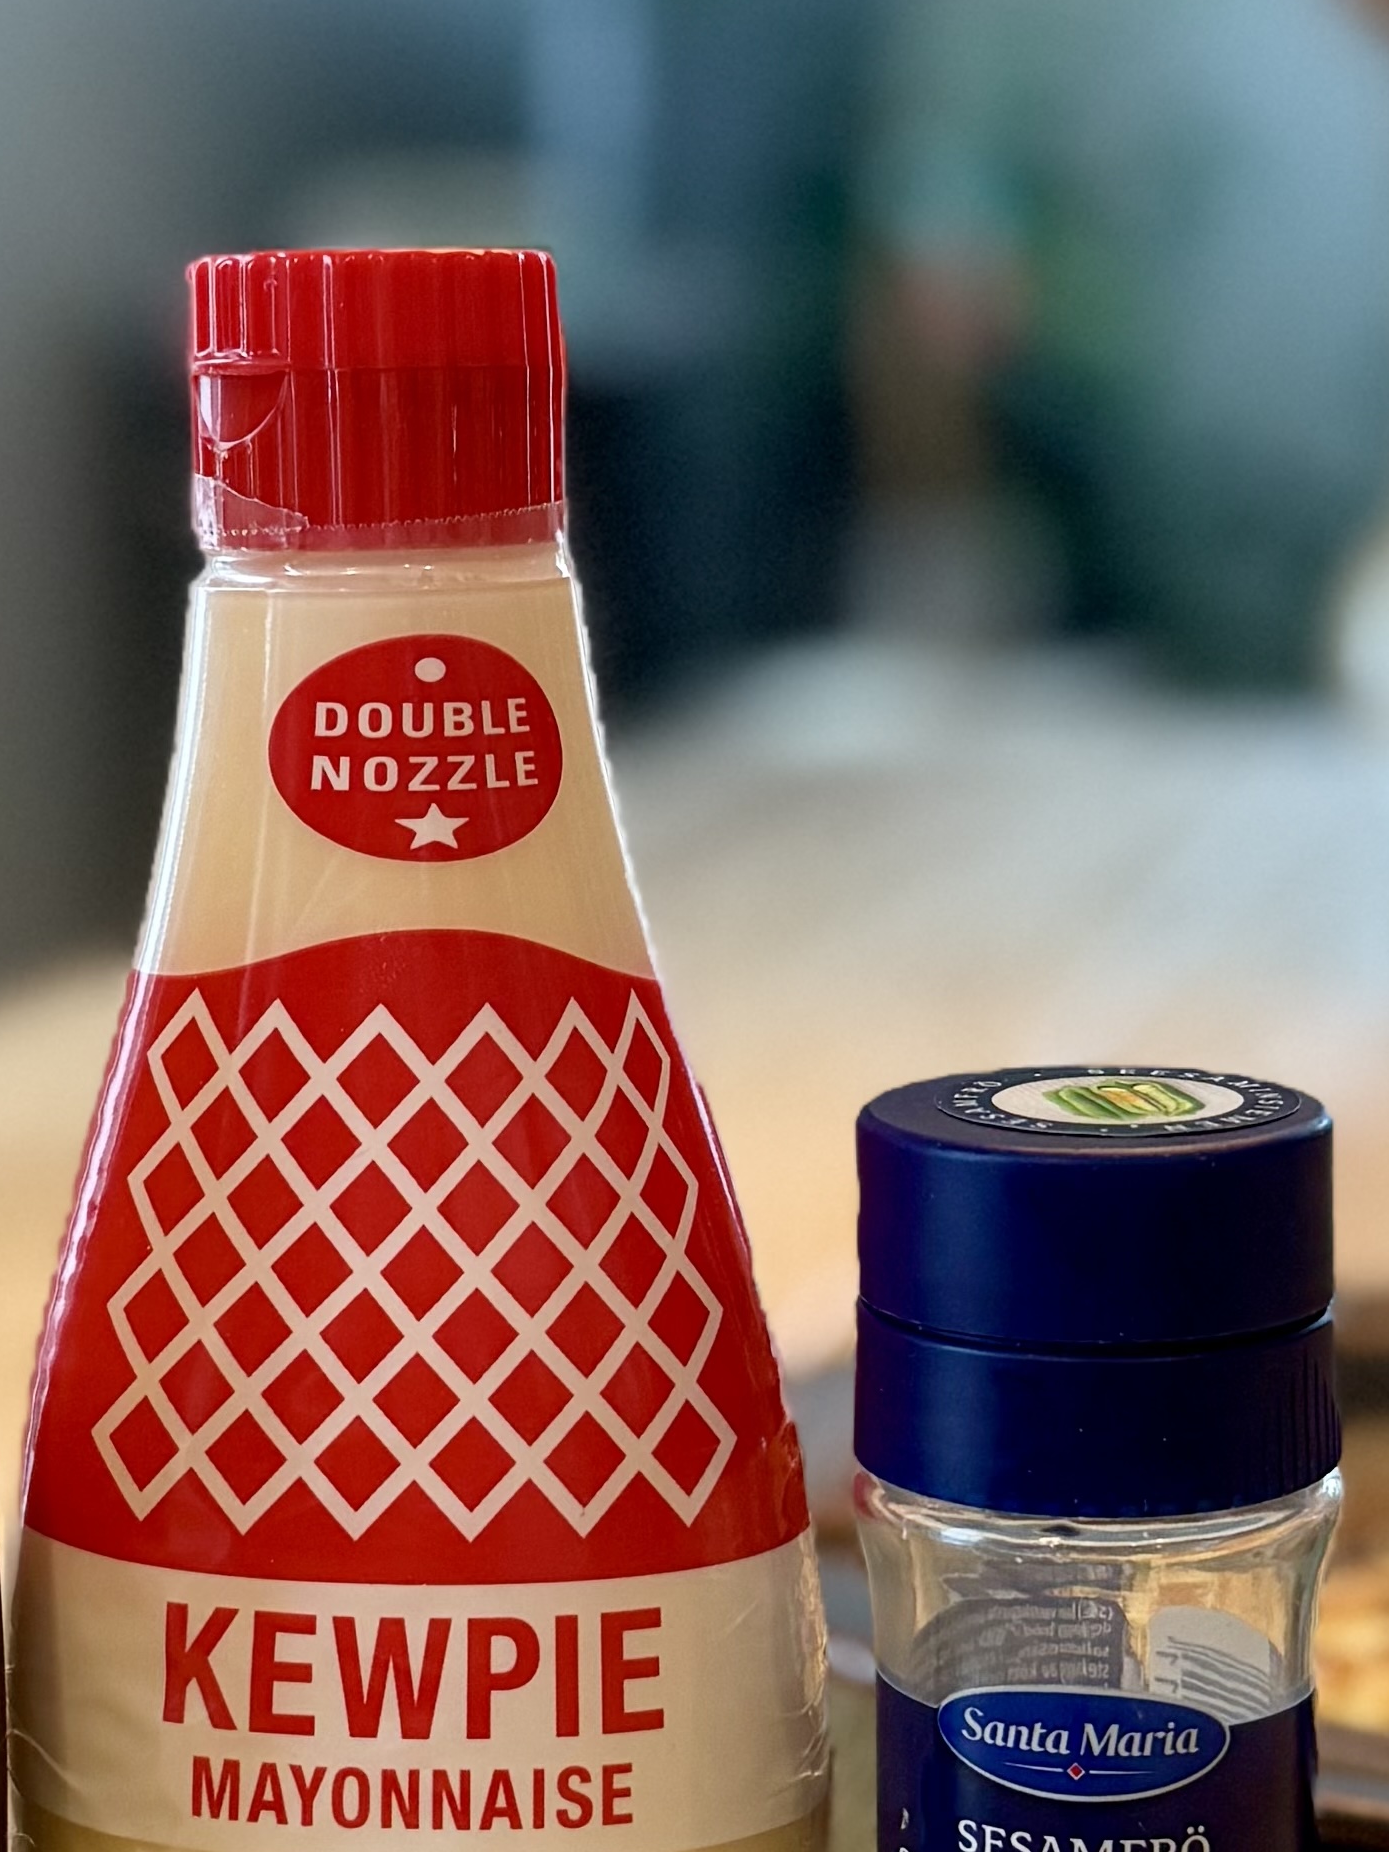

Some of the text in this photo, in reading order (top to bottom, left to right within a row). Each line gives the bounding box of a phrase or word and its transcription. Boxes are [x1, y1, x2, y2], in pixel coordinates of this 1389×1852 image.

[315, 697, 530, 738] DOUBLE
[311, 750, 538, 791] NOZZLE
[161, 1600, 665, 1740] KEWPIE
[961, 1707, 1199, 1757] Santa Maria
[190, 1756, 634, 1831] MAYONNAISE
